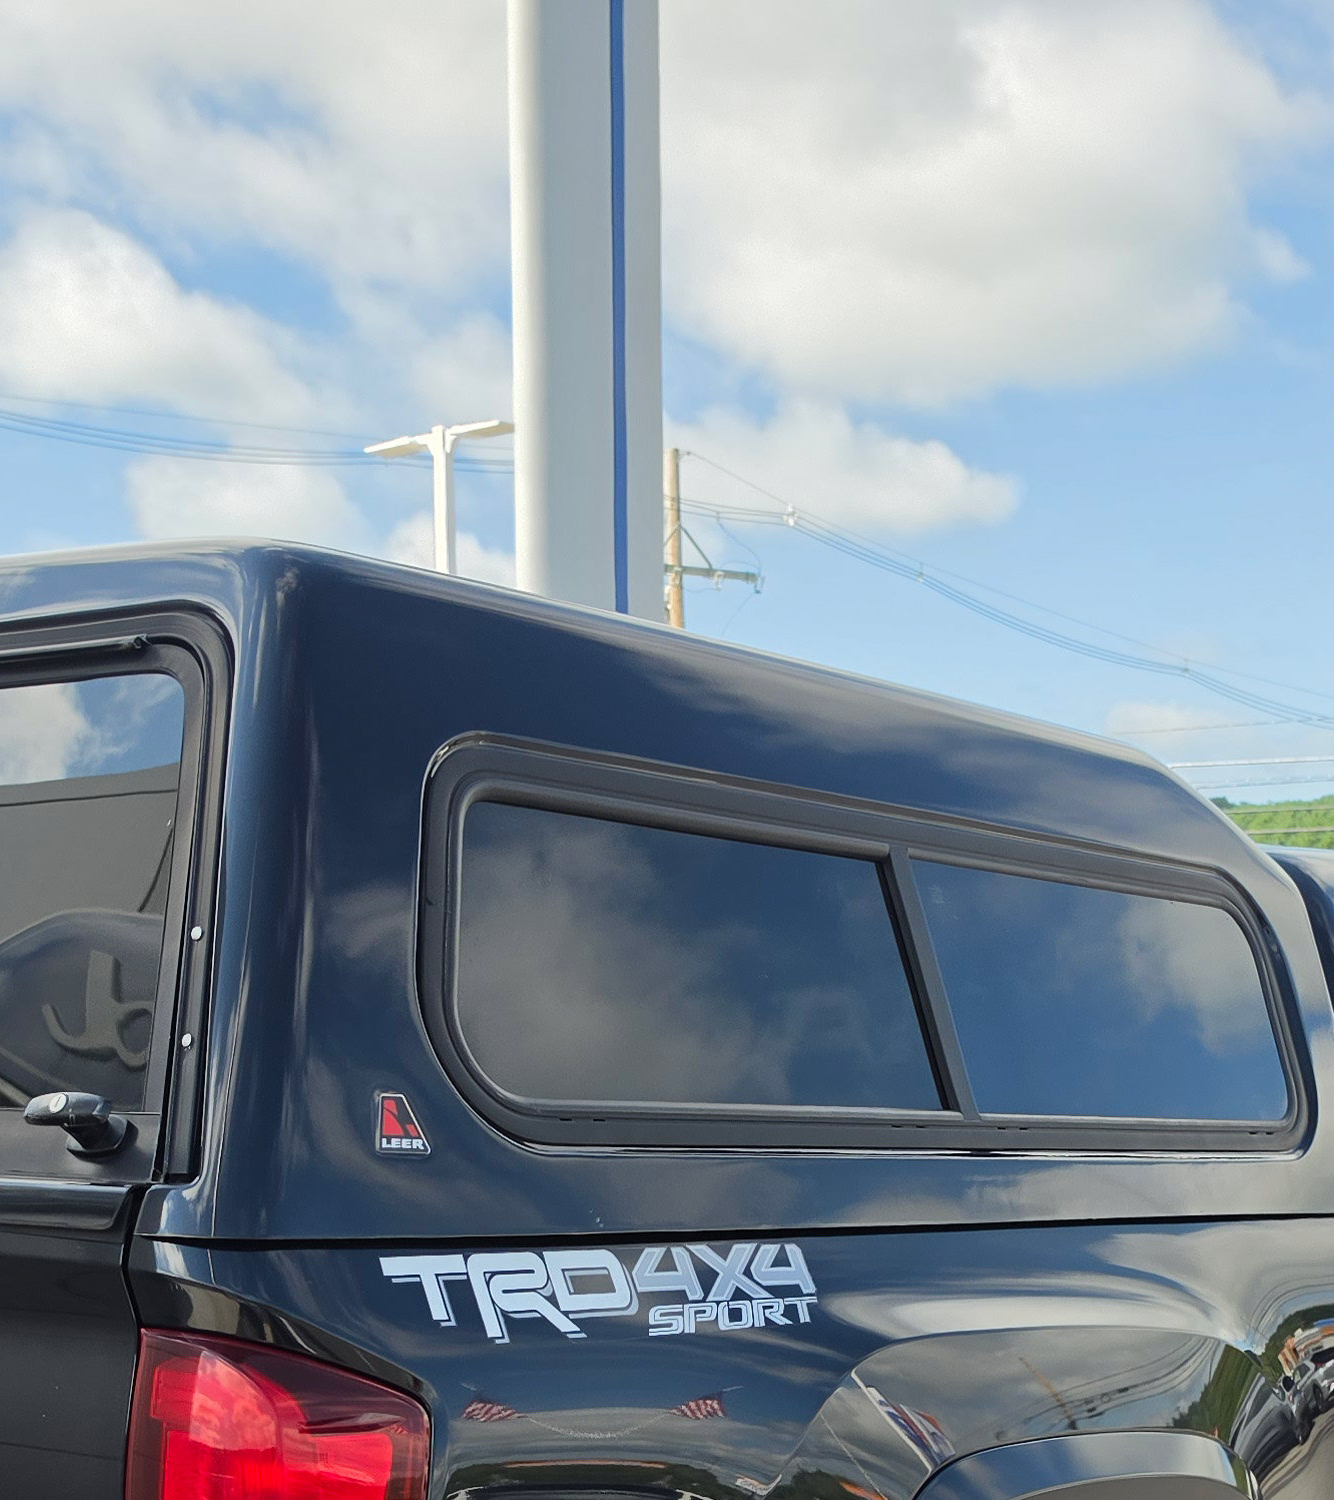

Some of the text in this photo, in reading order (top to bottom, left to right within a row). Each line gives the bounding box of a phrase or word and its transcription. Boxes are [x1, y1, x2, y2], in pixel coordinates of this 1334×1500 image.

[381, 1137, 425, 1150] LEER
[379, 1243, 817, 1344] TRD 4X4
[648, 1296, 818, 1336] SPORT
